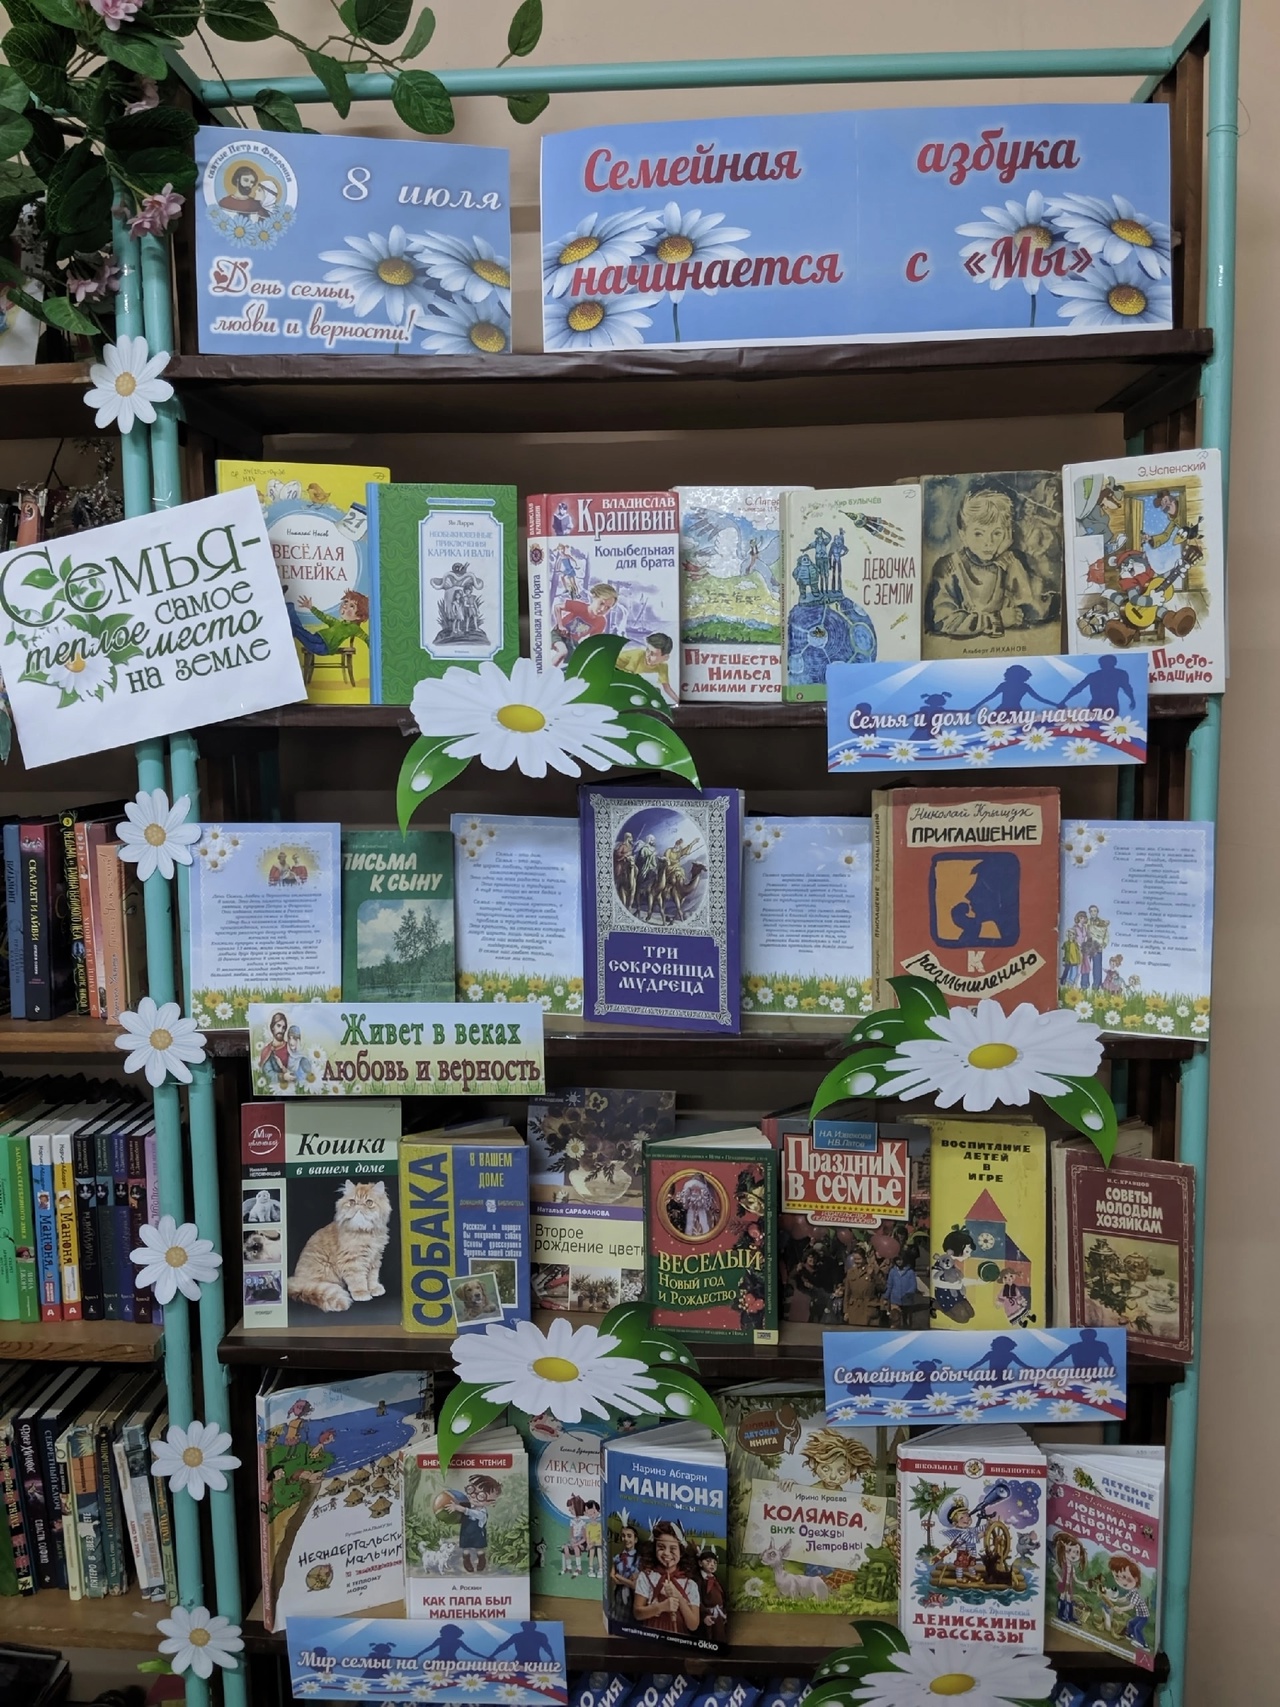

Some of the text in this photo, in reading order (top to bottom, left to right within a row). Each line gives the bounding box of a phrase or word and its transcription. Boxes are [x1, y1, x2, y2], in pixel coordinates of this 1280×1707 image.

[584, 128, 1080, 192] Семейная азбука
[342, 166, 501, 211] 8 июля
[570, 236, 1093, 298] начинается с «Мы»
[212, 259, 355, 304] День семьи,
[213, 303, 416, 346] любви и верности!
[602, 496, 676, 510] ВЛАДИСЛАВ
[344, 511, 366, 529] 21
[272, 542, 345, 562] ВЕСЁЛАЯ
[427, 548, 495, 558] КАРИКА И ВАЛИ
[594, 544, 675, 558] Колыбельная
[616, 557, 676, 571] для брата
[862, 556, 916, 581] ДЕВОЧКА
[532, 574, 544, 617] для брата
[863, 583, 914, 606] С ЗЕМЛИ
[146, 609, 263, 660] место
[26, 621, 150, 674] теплое
[989, 645, 1027, 654] ЛИХАНОВ
[126, 666, 164, 694] на
[708, 667, 771, 681] НИЛЬСА
[691, 683, 747, 694] ДИКИМИ
[849, 707, 1115, 736] Семья и дом всему начало
[910, 807, 970, 821] Николай
[911, 824, 1037, 844] ПРИГЛАШЕНИЕ
[28, 859, 40, 902] СКАРЛЕТ
[370, 873, 443, 893] К СЫНУ
[30, 914, 41, 941] АЙВИ
[72, 923, 84, 940] ЛЕСА
[643, 945, 679, 960] ТРИ
[608, 960, 716, 979] СОКРОВИЩА
[618, 976, 705, 996] МУДРЕЦА
[340, 1013, 522, 1045] Живет в веках
[322, 1050, 541, 1092] любовь и верность
[296, 1133, 386, 1156] Кошка
[941, 1139, 1031, 1153] ВОСПИТАНИЕ
[469, 1152, 513, 1168] В ВАШЕМ
[963, 1152, 1009, 1162] ДЕТЕЙ
[983, 1163, 991, 1171] В
[296, 1164, 386, 1175] в вашем доме
[968, 1173, 1004, 1183] ИГРЕ
[479, 1172, 505, 1189] ДОМЕ
[1105, 1187, 1153, 1205] СОВЕТЫ
[537, 1206, 610, 1217] Наталья САРАФАНОВА
[1096, 1200, 1163, 1220] МОЛОДЫМ
[534, 1223, 584, 1239] Второе
[1096, 1213, 1163, 1234] ХОЗЯЙКАМ
[60, 1212, 74, 1265] Манюня
[408, 1152, 453, 1327] СОБАКА
[534, 1240, 604, 1254] рождение
[657, 1245, 763, 1275] ВЕСЕЛЫЙ
[833, 1365, 1116, 1388] Семейные обычаи и традиции
[744, 1427, 780, 1440] ДЕТСКАЯ
[749, 1437, 778, 1448] КНИГА
[44, 1429, 60, 1511] СЕКРЕТНЫЙ КЛЮЧ
[479, 1459, 507, 1467] ЧТЕНИЕ
[544, 1459, 600, 1476] ЛЕКАРСТ
[632, 1462, 708, 1482] Наринэ Абгарян
[914, 1463, 1042, 1475] ШКОЛЬНАЯ БИБЛИОТЕКА
[544, 1476, 554, 1484] ОТ
[1101, 1477, 1155, 1502] ДЕТСКОЕ
[620, 1474, 724, 1509] МАНЮНЯ
[795, 1492, 847, 1502] Ирина Краева
[1105, 1487, 1151, 1510] ЧТЕНИЕ
[763, 1503, 868, 1532] КОЛЯМБА,
[1067, 1500, 1137, 1533] ЛЮБИМАЯ
[1070, 1511, 1134, 1542] ДЕВОЧКА
[799, 1524, 845, 1539] Одежды
[1054, 1516, 1150, 1560] ДЯДИ ФЁДОРА
[805, 1540, 863, 1552] Петровны
[422, 1596, 512, 1606] КАК ПАПА БЫЛ
[429, 1608, 506, 1619] МАЛЕНЬКИМ
[912, 1613, 1037, 1631] ДЕНИСКИНЫ
[297, 1651, 563, 1680] Мир семьи на страницах книг
